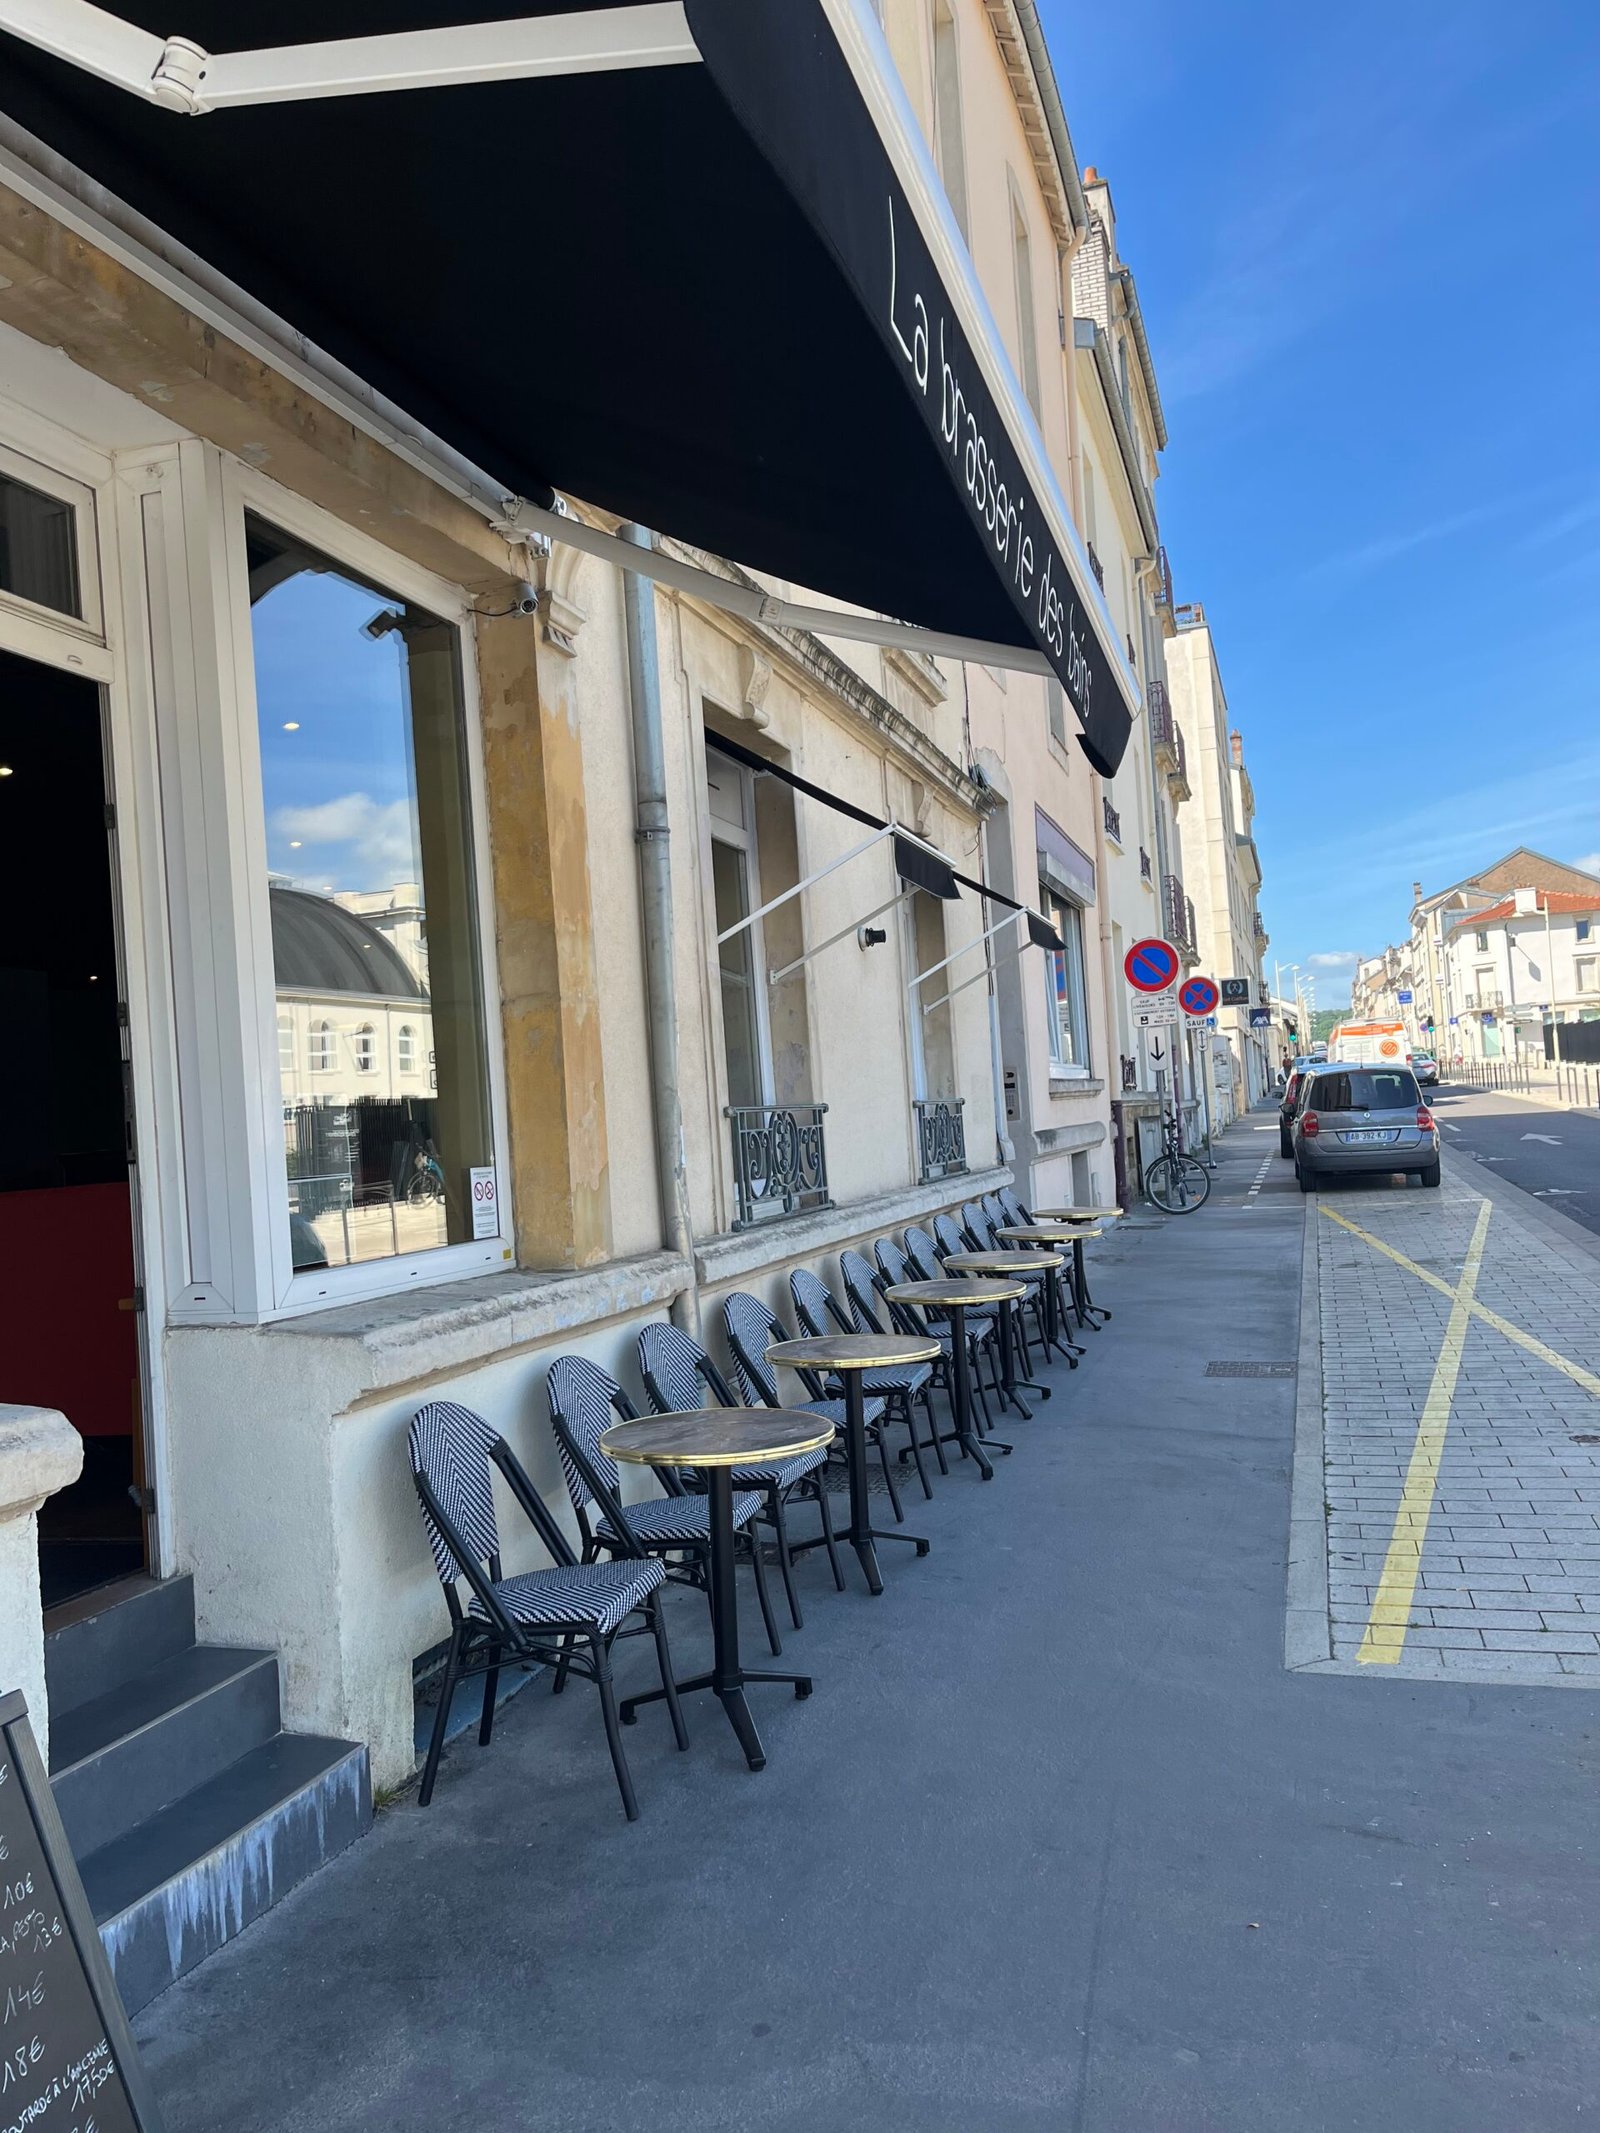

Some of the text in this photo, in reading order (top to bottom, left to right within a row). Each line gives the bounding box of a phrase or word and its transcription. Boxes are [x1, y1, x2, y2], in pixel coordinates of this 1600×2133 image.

[888, 195, 1093, 719] La brasserie des bains
[1187, 1019, 1206, 1027] SAUF
[1252, 1015, 1269, 1025] AXA
[4, 1872, 34, 1910] 10€
[33, 1916, 62, 1953] 13€
[3, 1970, 46, 2025] 14€
[2, 2035, 46, 2094] 18€
[71, 2059, 115, 2113] 17,50€
